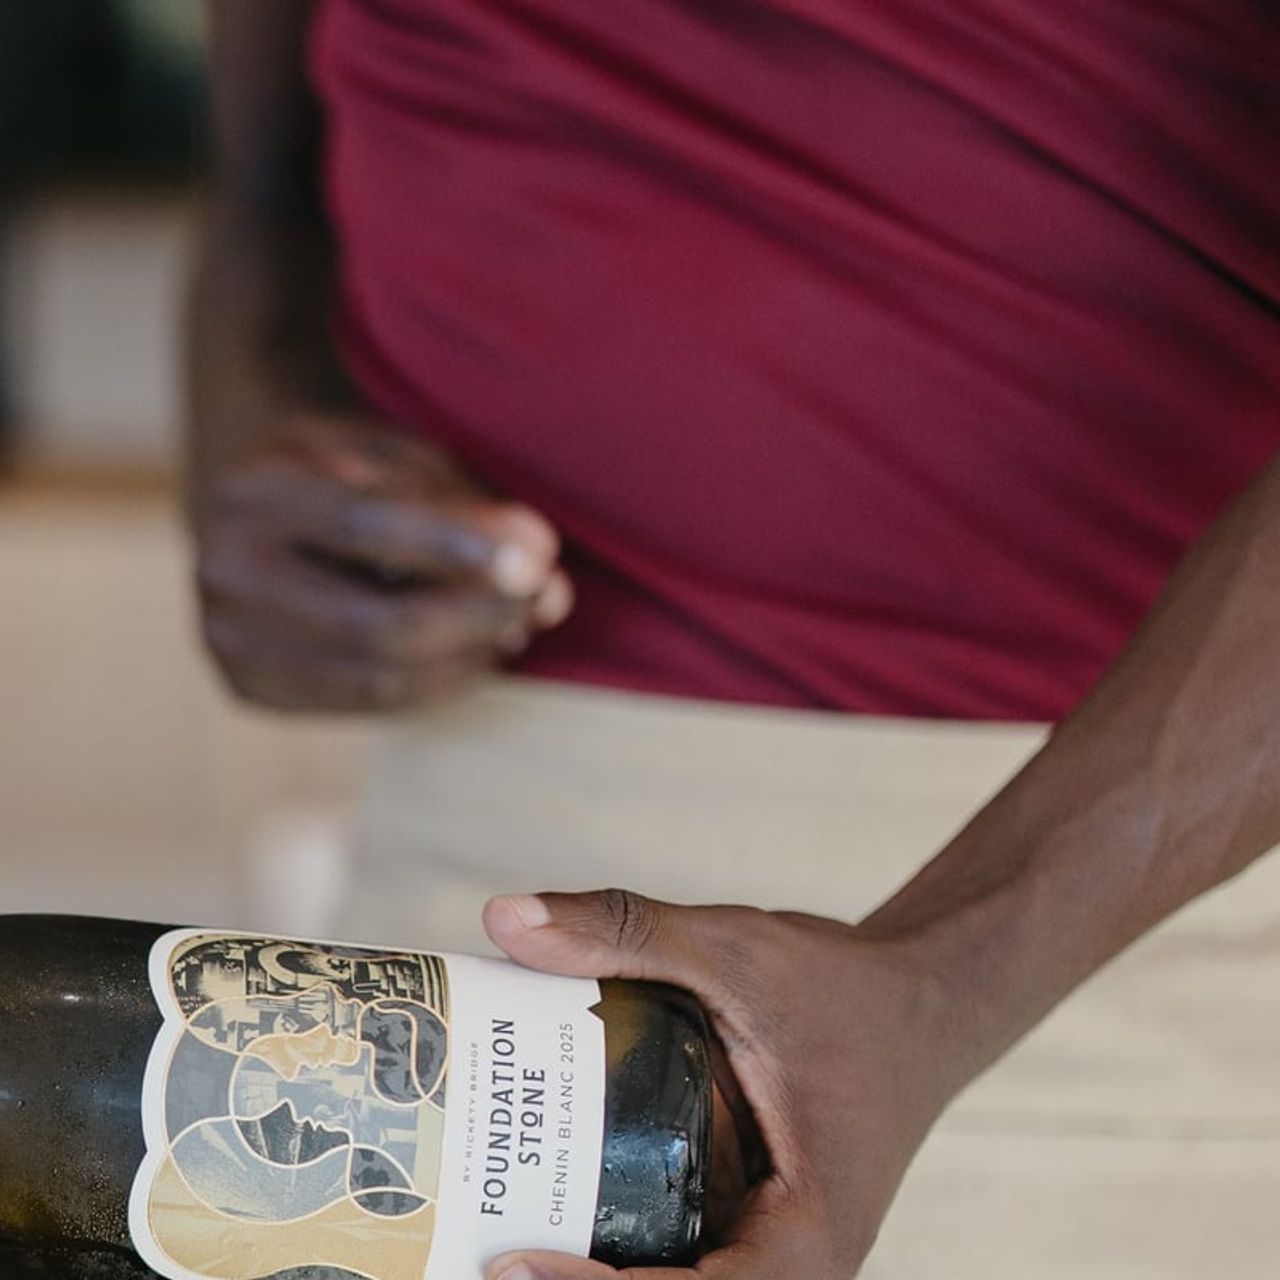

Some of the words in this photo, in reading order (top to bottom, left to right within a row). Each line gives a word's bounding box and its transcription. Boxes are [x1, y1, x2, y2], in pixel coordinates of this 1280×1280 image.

[469, 1042, 479, 1092] BRIDGE
[559, 1023, 575, 1064] 2025
[464, 1098, 477, 1159] RICKETY
[480, 1018, 516, 1217] FOUNDATION
[517, 1067, 546, 1167] STONE
[557, 1071, 575, 1140] BLANC
[462, 1164, 471, 1183] BY
[549, 1148, 570, 1227] CHENIN
